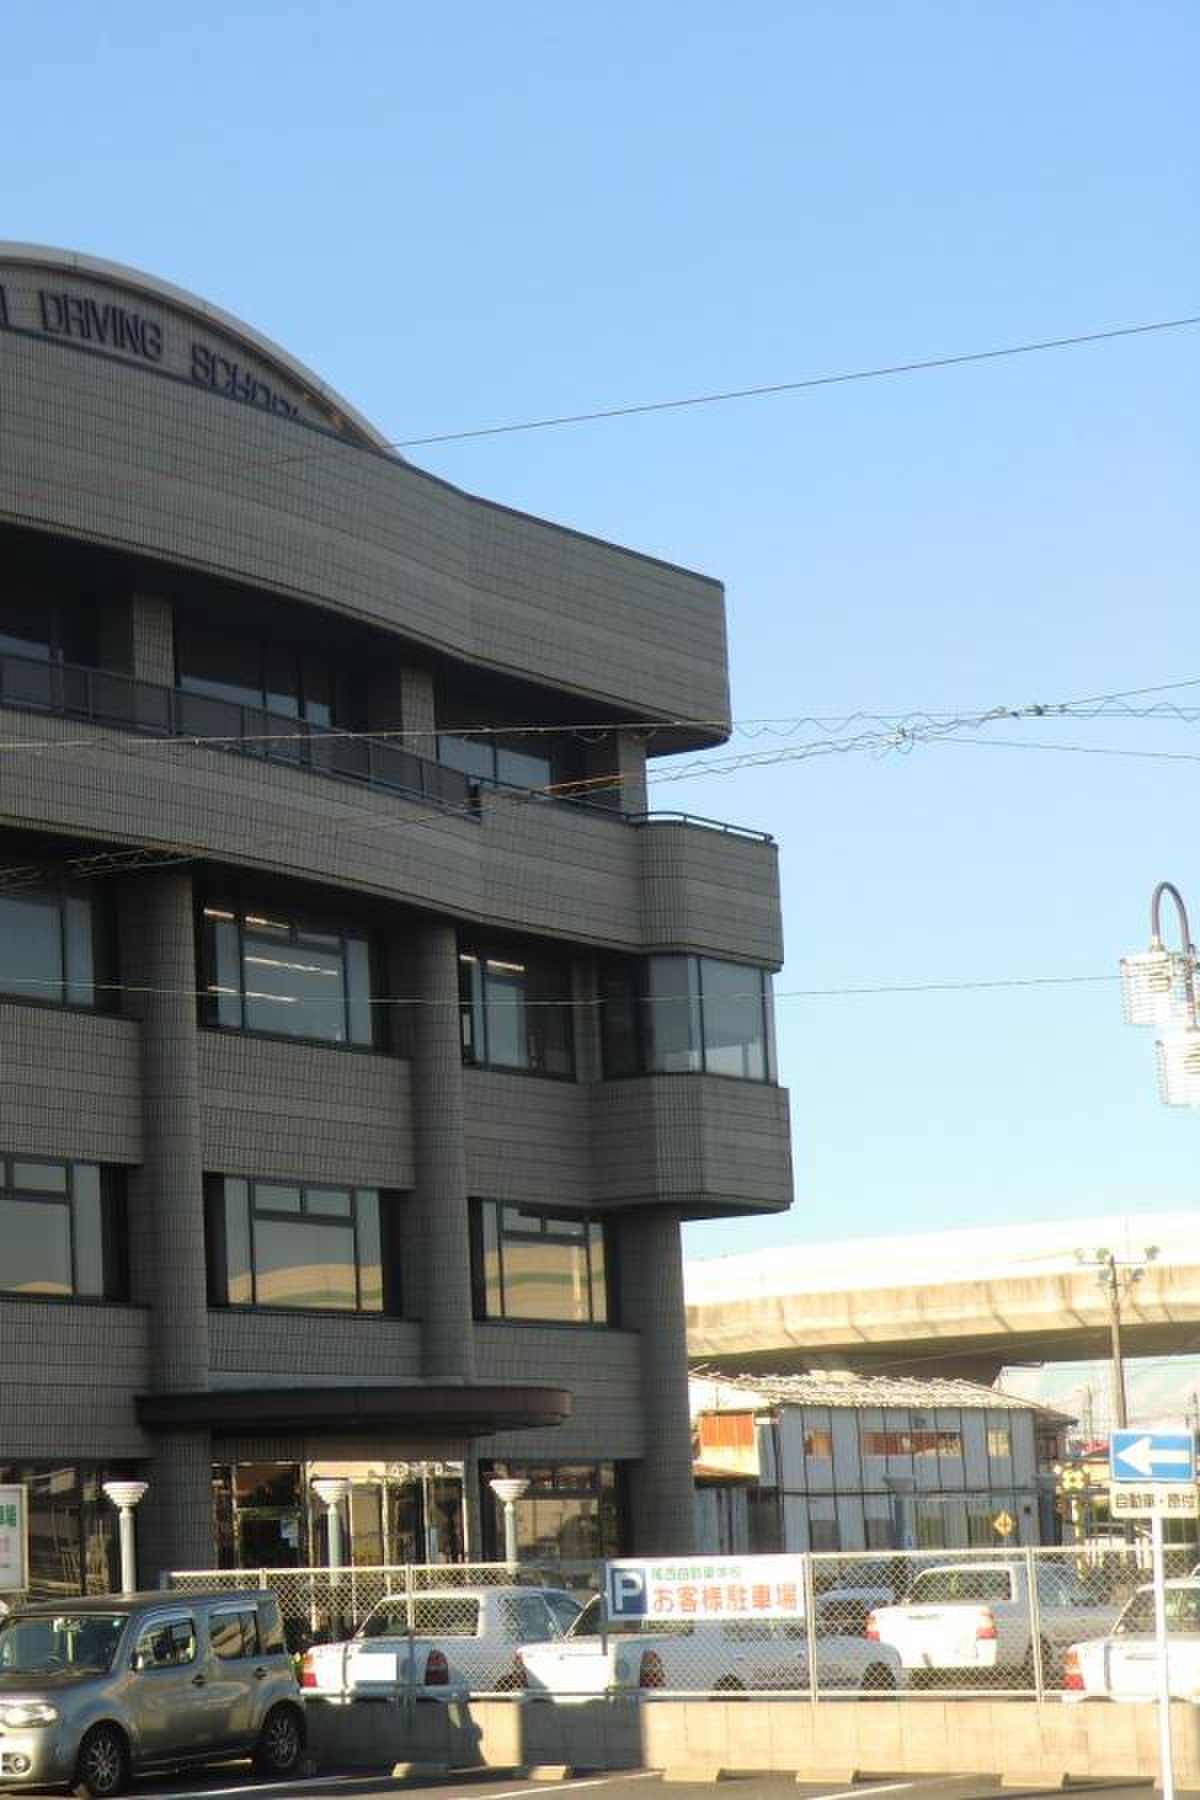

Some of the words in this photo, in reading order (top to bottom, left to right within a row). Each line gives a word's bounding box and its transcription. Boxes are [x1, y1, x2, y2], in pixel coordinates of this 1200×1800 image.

[40, 288, 161, 361] DRIVING
[613, 1571, 642, 1611] P
[654, 1583, 798, 1613] お客様駐車場
